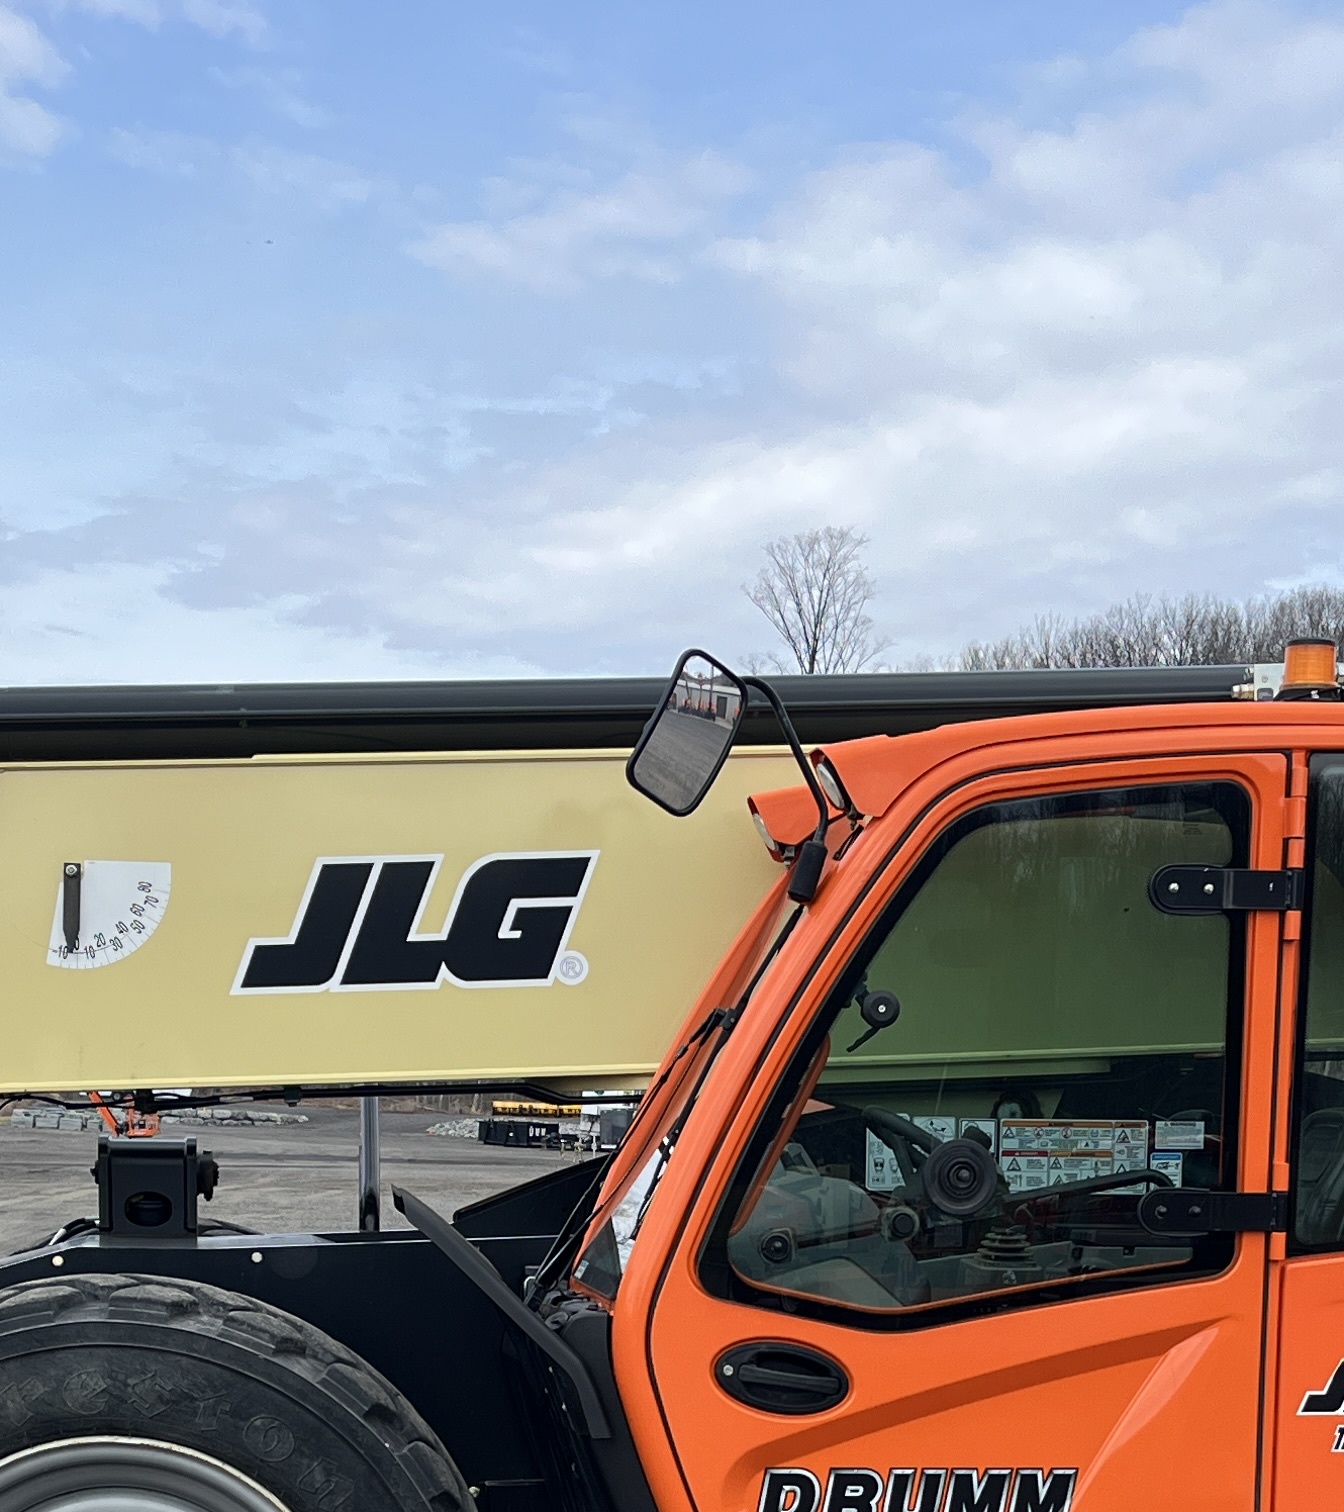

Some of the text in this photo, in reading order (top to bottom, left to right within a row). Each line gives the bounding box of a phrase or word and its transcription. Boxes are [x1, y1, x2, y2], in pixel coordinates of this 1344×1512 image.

[144, 895, 159, 909] 70
[130, 903, 145, 917] 60
[115, 920, 129, 935] 40
[130, 919, 146, 934] 50
[238, 856, 592, 990] JLG
[94, 932, 106, 947] 20
[109, 936, 123, 951] 30
[84, 945, 96, 959] 10
